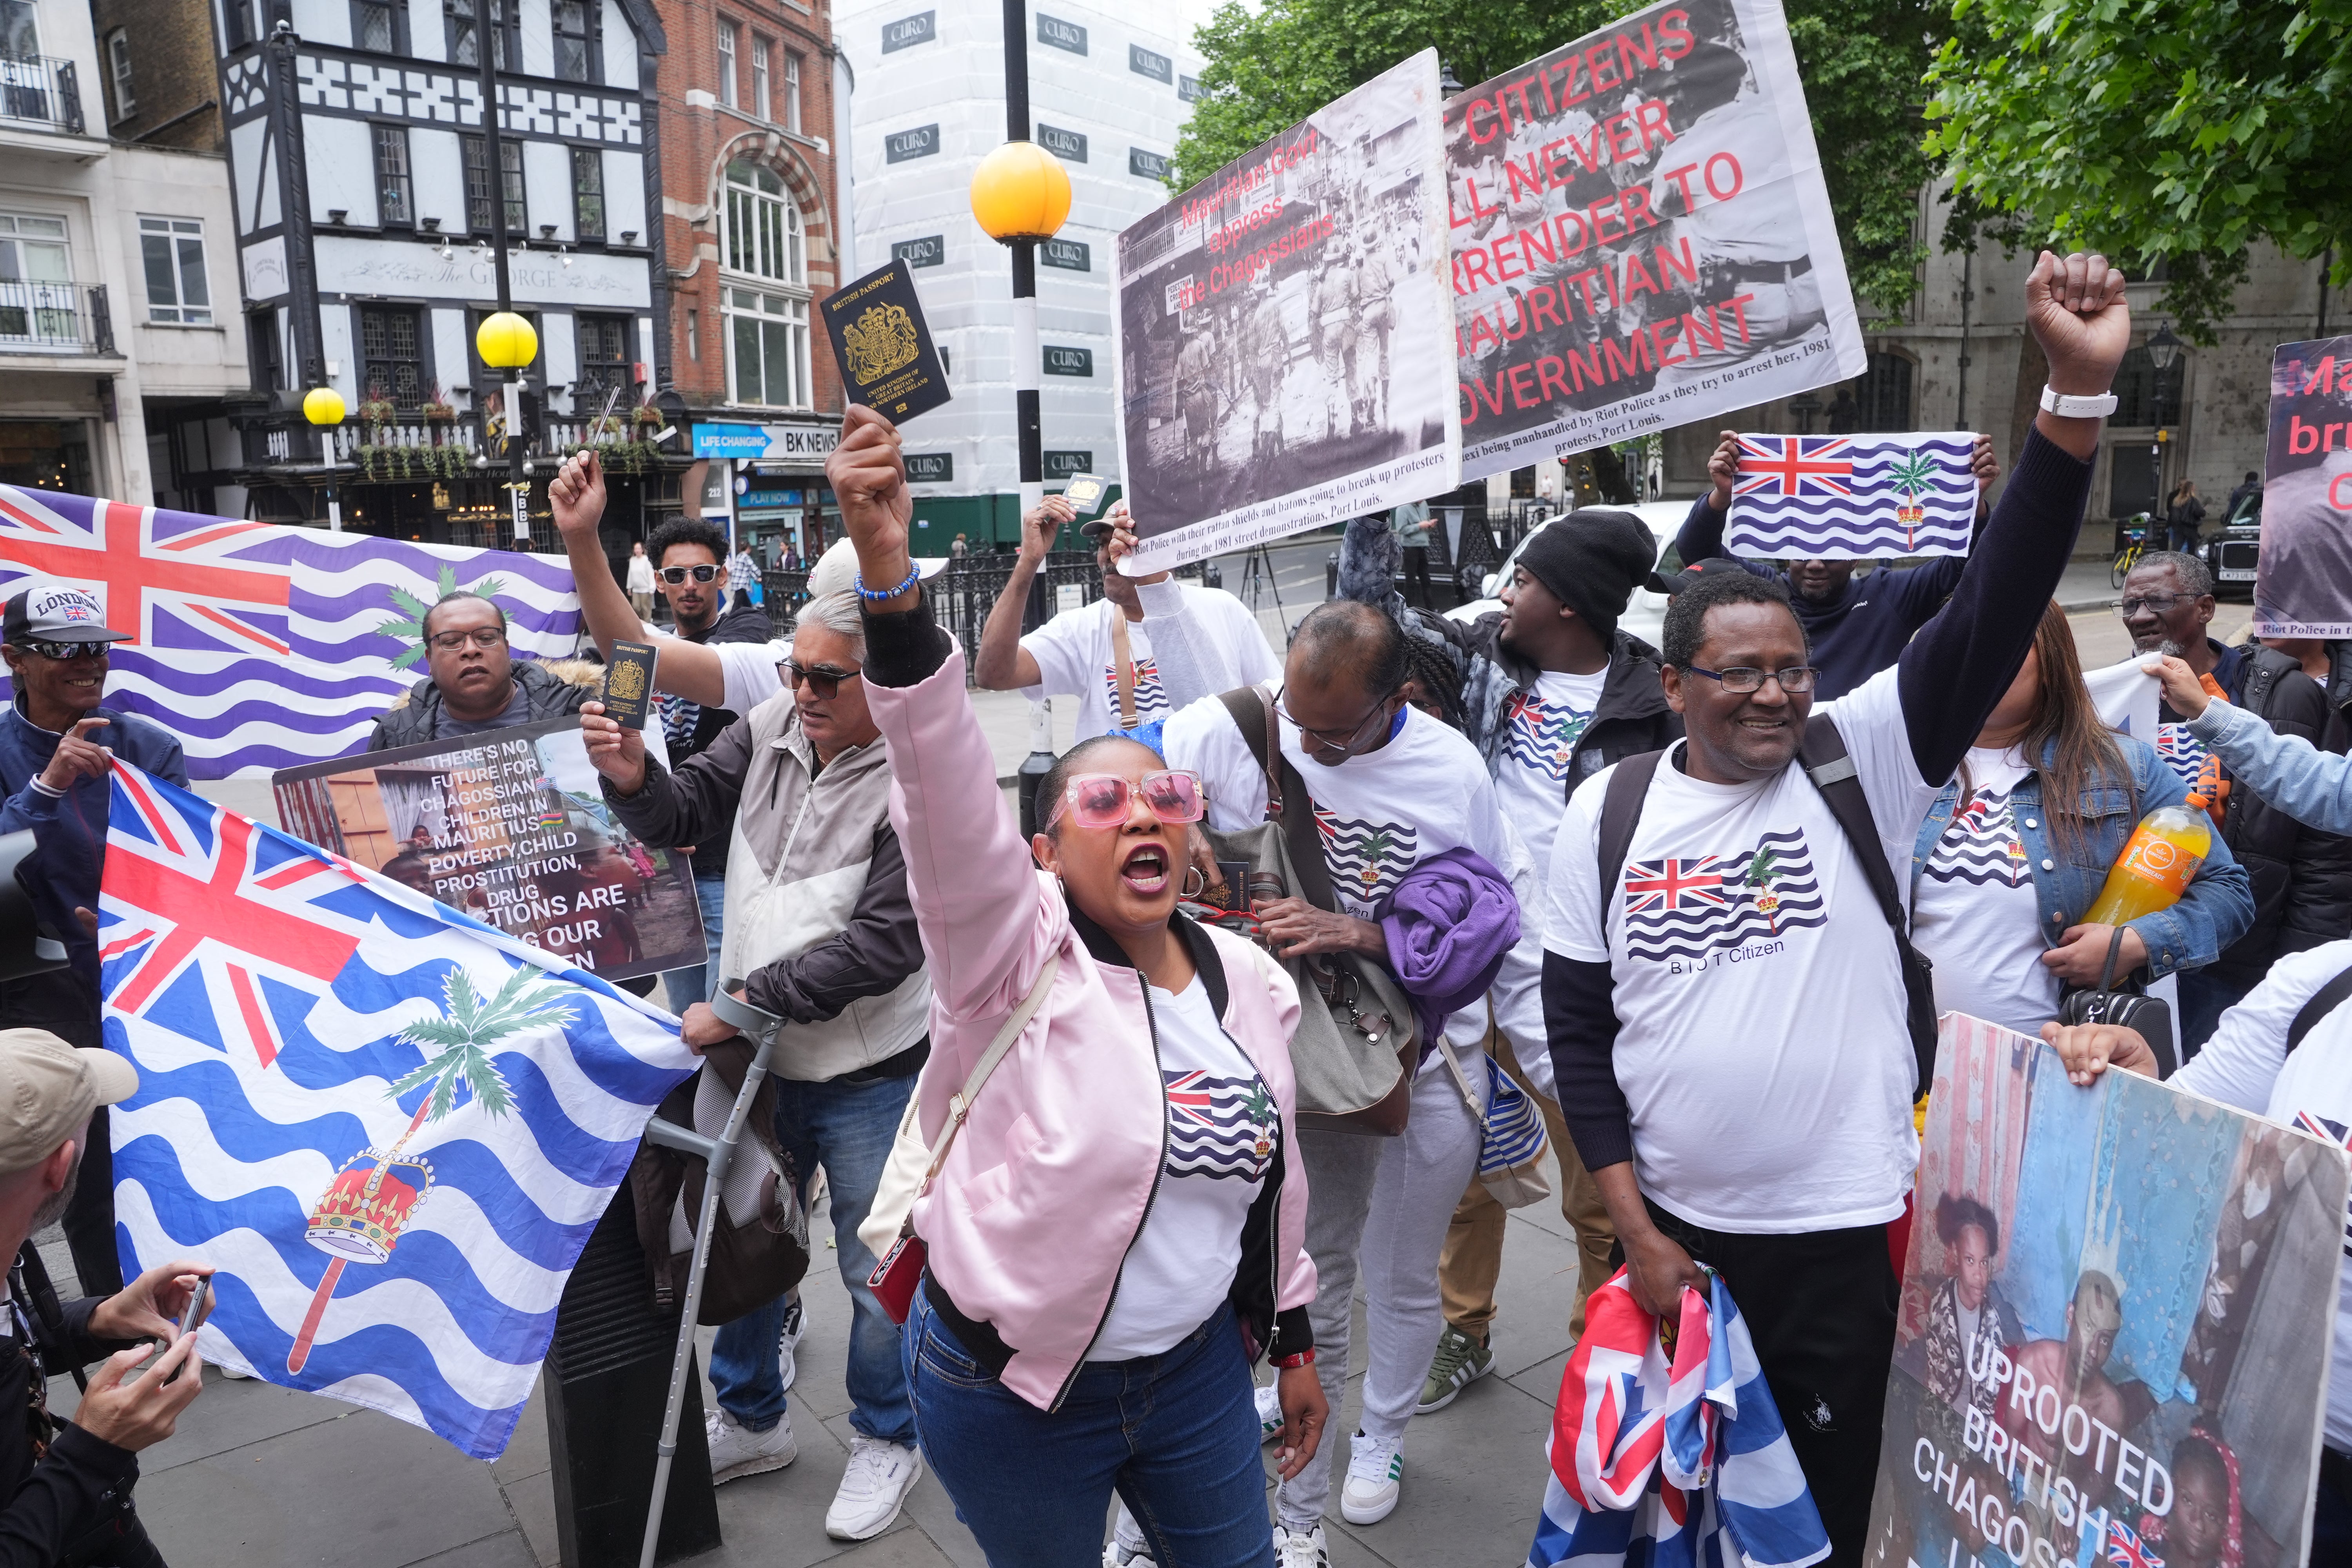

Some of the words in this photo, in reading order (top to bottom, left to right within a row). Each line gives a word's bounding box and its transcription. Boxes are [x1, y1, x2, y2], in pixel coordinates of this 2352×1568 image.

[891, 17, 927, 42] CURO
[1045, 20, 1080, 44] CURO
[1137, 51, 1166, 73] CURO
[1465, 9, 1695, 145] CITIZENS
[894, 130, 930, 152] CURO
[1045, 131, 1080, 152] CURO
[1505, 100, 1676, 203] NEVER
[1137, 154, 1167, 174] CURO
[1182, 164, 1265, 229] Mauritian
[1271, 129, 1318, 176] Govt
[1664, 151, 1743, 214] TO
[1210, 197, 1283, 254] oppress
[899, 241, 935, 260] CURO
[1048, 241, 1083, 261] CURO
[1179, 281, 1205, 310] the
[1210, 213, 1333, 293] Chagossians
[470, 263, 557, 288] GORGE
[832, 291, 860, 312] BRITISH
[860, 272, 894, 296] PASSPORT
[1174, 298, 1187, 310] AHED
[1051, 350, 1085, 367] CURO
[867, 384, 886, 398] UNITED
[886, 372, 912, 390] KINGDOM
[912, 368, 919, 377] OF
[876, 389, 892, 400] GREAT
[893, 377, 915, 393] BRITAIN
[877, 389, 906, 406] NORTHERN
[905, 377, 928, 393] IRELAND
[1482, 439, 1511, 456] being
[1512, 420, 1577, 447] manhandled
[1580, 414, 1593, 427] by
[1596, 407, 1619, 423] Riot
[1621, 397, 1655, 416] Police
[1658, 392, 1671, 403] as
[1674, 383, 1698, 397] they
[1701, 376, 1719, 391] try
[1722, 372, 1734, 383] to
[1737, 358, 1773, 378] arrest
[1775, 351, 1800, 366] her,
[1803, 338, 1831, 357] 1981
[701, 436, 720, 447] LIFE
[721, 436, 766, 447] CHANGING
[786, 433, 804, 452] BK
[808, 434, 836, 452] NEWS
[1555, 430, 1602, 455] protests,
[1602, 422, 1626, 439] Port
[1629, 412, 1665, 430] Louis.
[908, 457, 944, 474] CURO
[1051, 454, 1085, 470] CURO
[708, 487, 721, 498] 212
[750, 494, 770, 504] PLAY
[771, 493, 790, 503] NOW
[1135, 542, 1149, 556] Riot
[1151, 538, 1170, 552] Police
[1172, 530, 1186, 545] with
[1188, 525, 1205, 539] their
[1207, 519, 1230, 534] rattan
[1232, 508, 1259, 526] shields
[1262, 503, 1276, 517] and
[1278, 496, 1307, 512] batons
[1310, 487, 1335, 507] going
[1337, 484, 1345, 495] to
[1348, 472, 1376, 492] break
[1379, 470, 1391, 484] up
[1394, 452, 1444, 481] protesters
[1176, 543, 1200, 561] during
[1201, 541, 1212, 554] the
[1215, 535, 1232, 550] 1981
[1235, 530, 1258, 545] street
[1260, 511, 1328, 537] demonstrations,
[1331, 503, 1351, 518] Port
[1354, 492, 1383, 511] Louis.
[35, 593, 101, 617] LONDON
[2262, 624, 2286, 633] Riot
[2289, 625, 2326, 634] Police
[2330, 625, 2341, 634] in
[425, 745, 497, 769] THERE'S
[501, 739, 529, 757] NO
[431, 762, 501, 791] FUTURE
[503, 759, 538, 779] FOR
[420, 779, 536, 813] CHAGOSSIAN
[438, 802, 528, 831] CHILDREN
[532, 796, 549, 815] IN
[433, 816, 540, 849] MAURITIUS
[2147, 850, 2171, 863] KINGSLEY
[435, 854, 582, 896] PROSTITUTION,
[2134, 862, 2166, 882] ORANGEADE
[486, 884, 540, 908] DRUG
[487, 895, 568, 928] TIONS
[575, 883, 626, 912] ARE
[1344, 904, 1368, 918] izen
[547, 919, 602, 947] OUR
[1729, 941, 1784, 963] Citizen
[1966, 1331, 2174, 1517] UPROOTED
[887, 1462, 899, 1479] Reebok
[1963, 1403, 2109, 1555] BRITISH
[1913, 1437, 2082, 1568] CHAGOS
